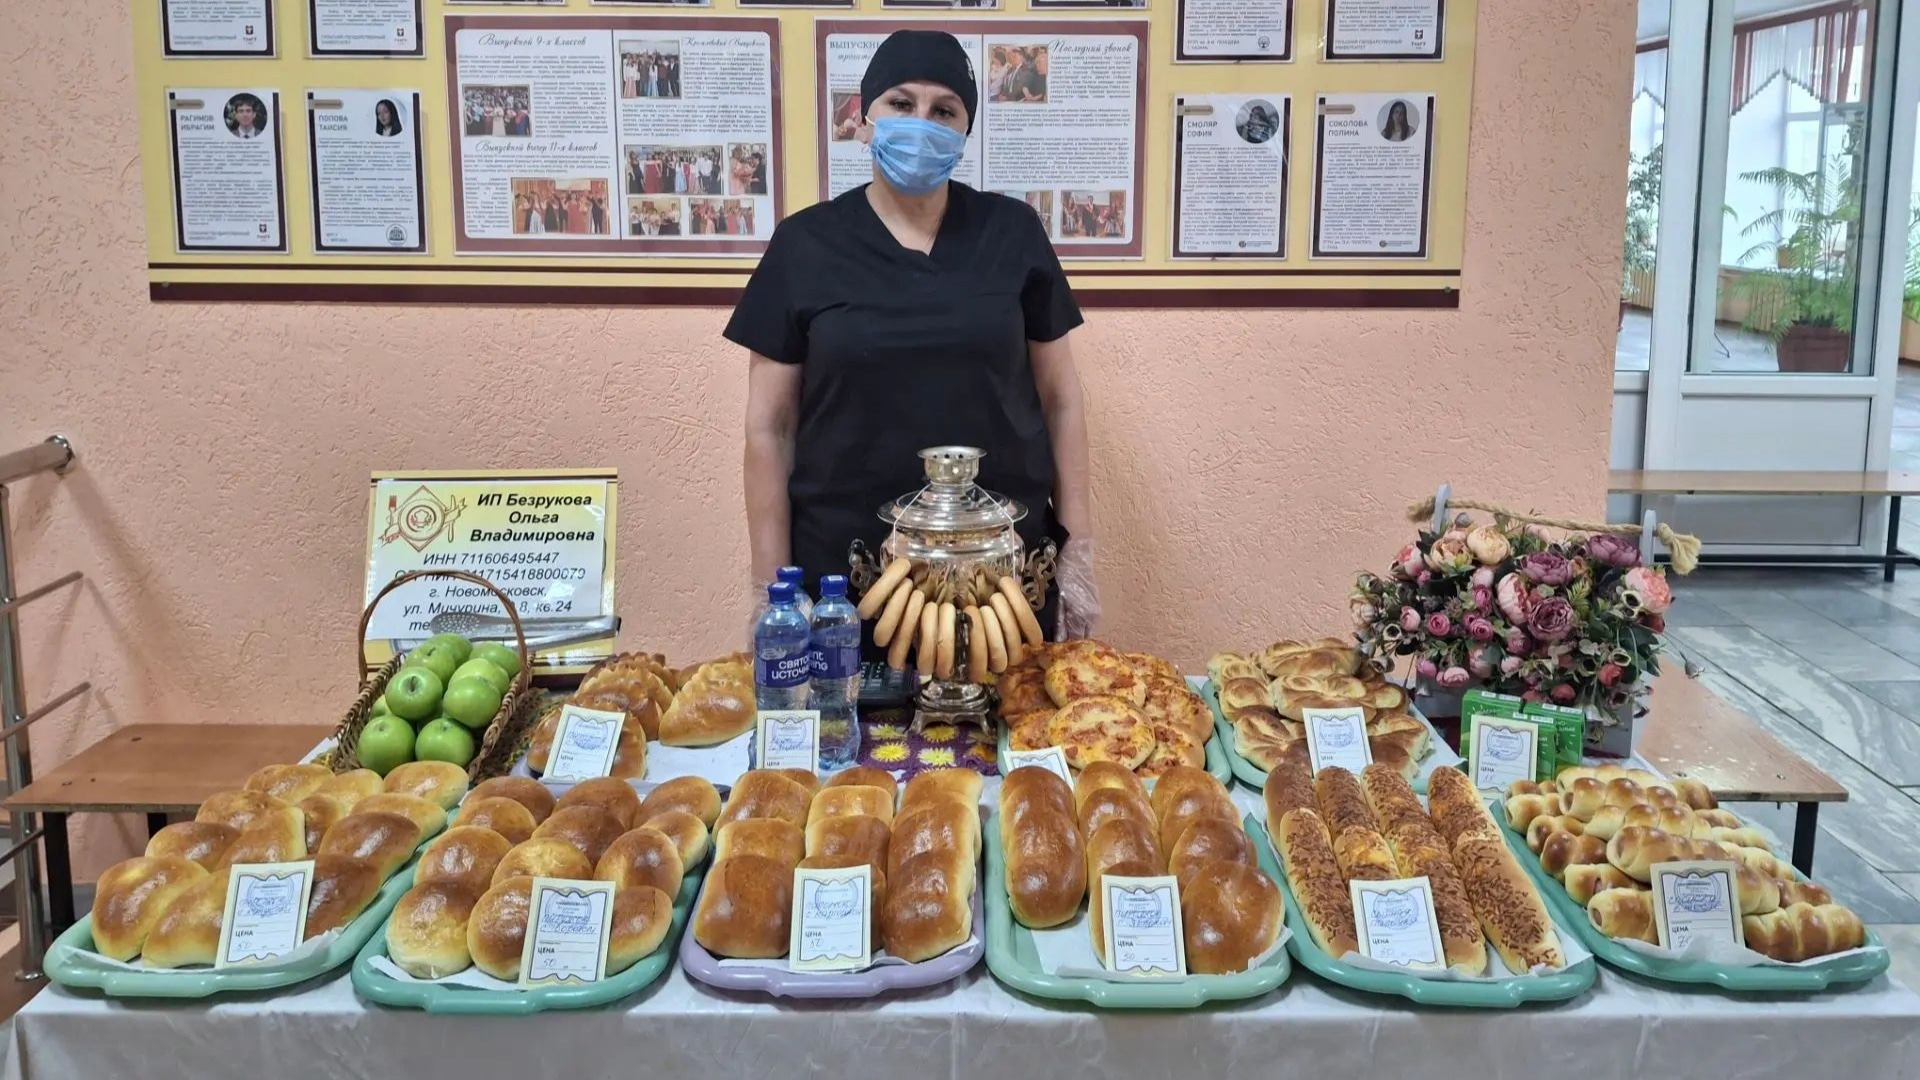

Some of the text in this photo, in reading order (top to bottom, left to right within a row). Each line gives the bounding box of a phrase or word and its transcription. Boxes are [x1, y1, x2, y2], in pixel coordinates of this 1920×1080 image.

[477, 494, 592, 509] ИП Безрукова
[509, 511, 559, 523] Ольга
[470, 529, 595, 543] Владимировна
[424, 552, 559, 565] ИНН 711606495447
[429, 588, 439, 598] г.
[403, 604, 422, 617] ул.
[1671, 926, 1689, 934] ЦЕНА
[537, 946, 555, 954] ЦЕНА
[1117, 940, 1134, 948] ЦЕНА
